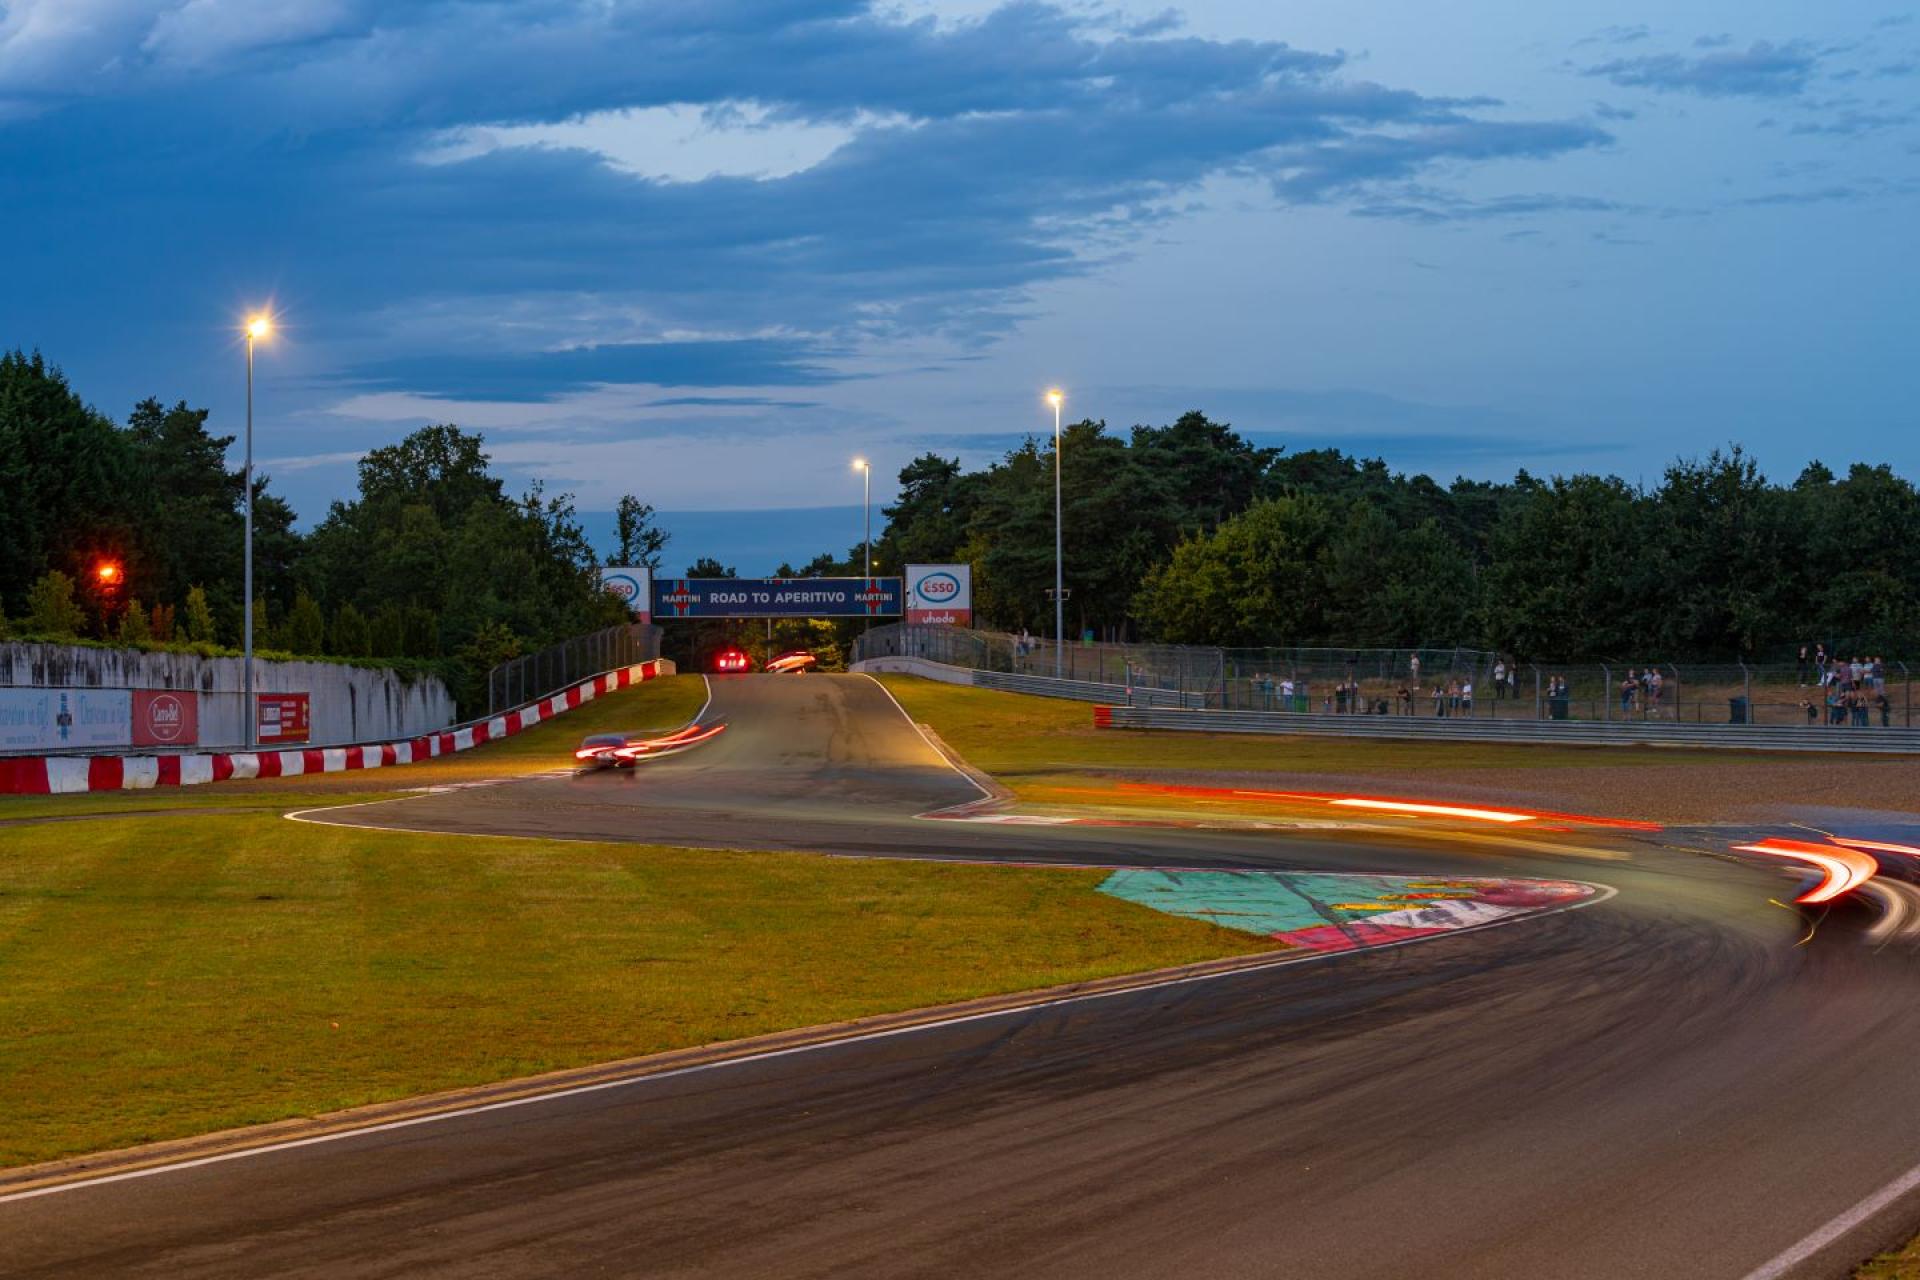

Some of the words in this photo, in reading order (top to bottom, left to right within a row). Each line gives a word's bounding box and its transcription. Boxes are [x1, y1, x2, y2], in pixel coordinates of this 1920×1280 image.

[662, 594, 700, 604] MARTINI
[710, 592, 747, 604] ROAD
[751, 592, 770, 604] TO
[775, 591, 845, 603] APERITIVO
[854, 592, 893, 602] MARTINI
